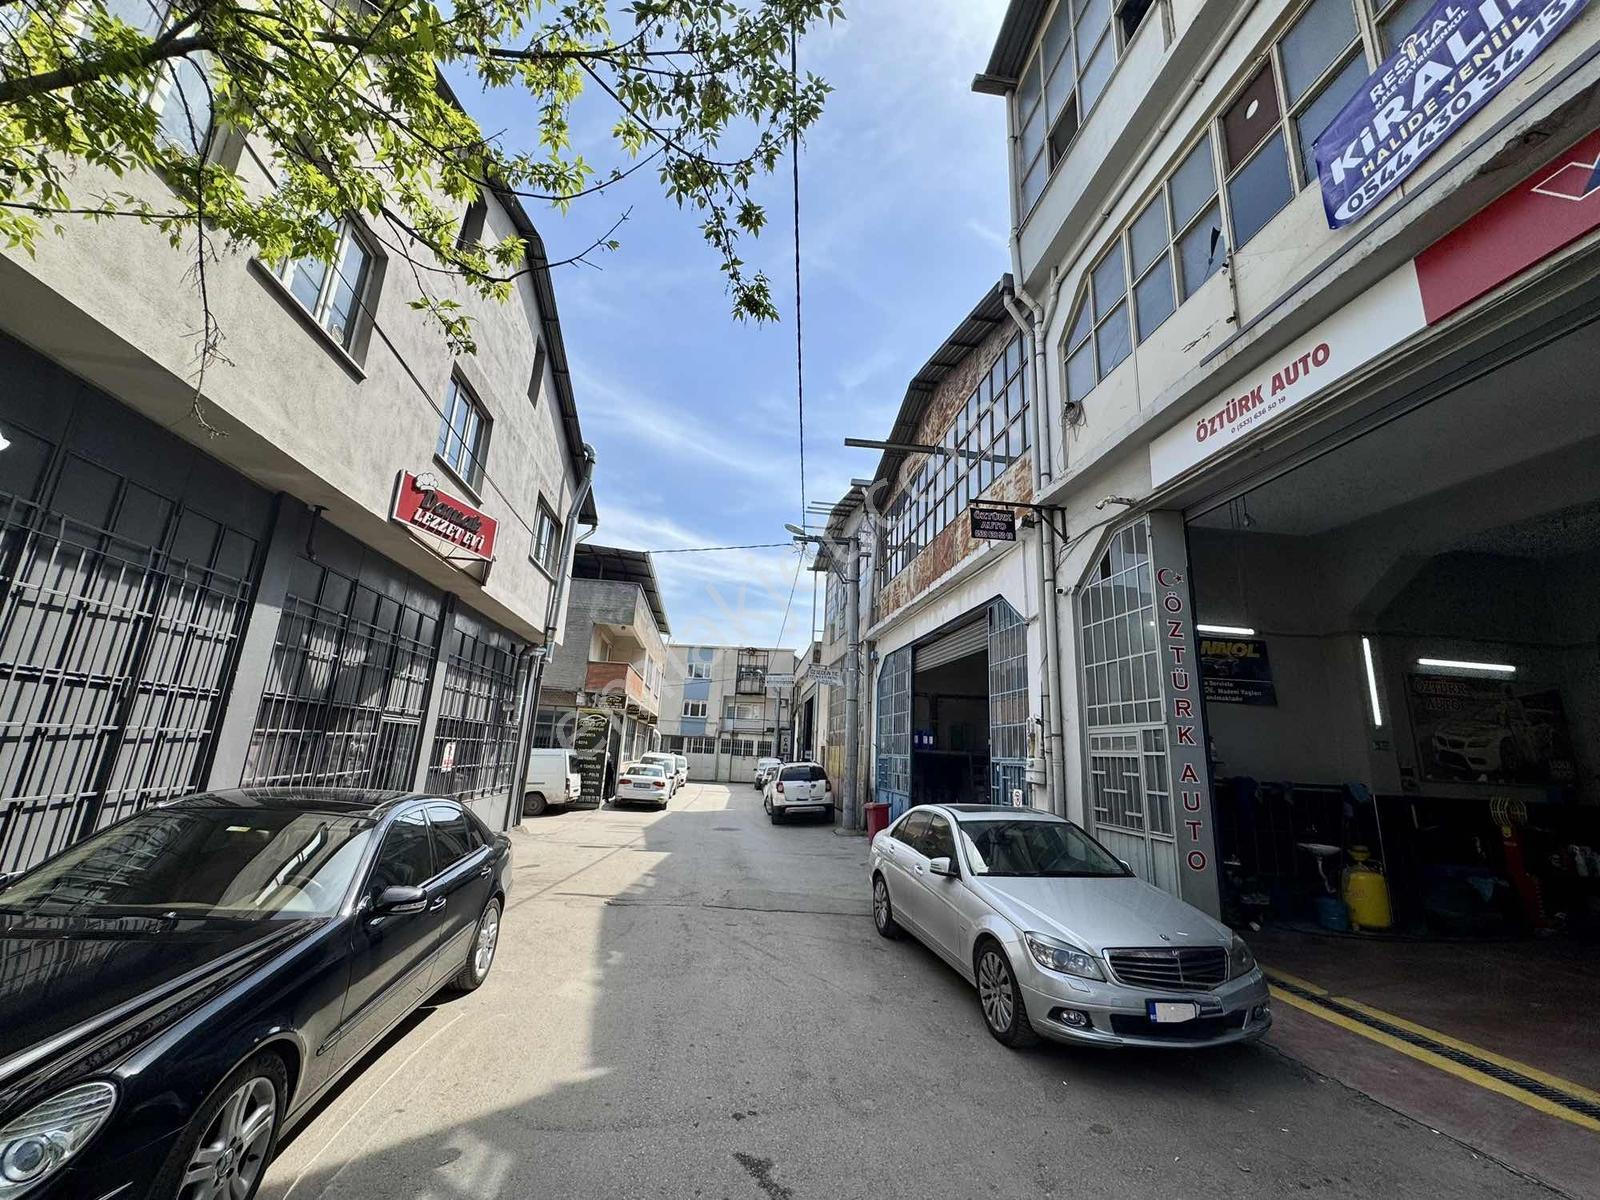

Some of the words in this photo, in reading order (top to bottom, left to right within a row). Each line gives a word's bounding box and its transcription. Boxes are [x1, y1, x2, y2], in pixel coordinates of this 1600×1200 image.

[1346, 152, 1413, 213] 0544
[1417, 91, 1472, 148] 430
[1478, 47, 1526, 90] 34
[1361, 97, 1438, 178] HALİDE
[1374, 84, 1400, 110] KALE
[1196, 384, 1264, 442] ÖZTÜRK
[1271, 342, 1331, 396] AUTO
[414, 508, 464, 539] LEZZET
[464, 530, 485, 549] EVİ
[973, 510, 1013, 521] ÖZTÜRK
[980, 521, 1007, 530] AUTO
[1164, 591, 1197, 746] ÖZTÜRK
[1180, 763, 1208, 872] AUTO
